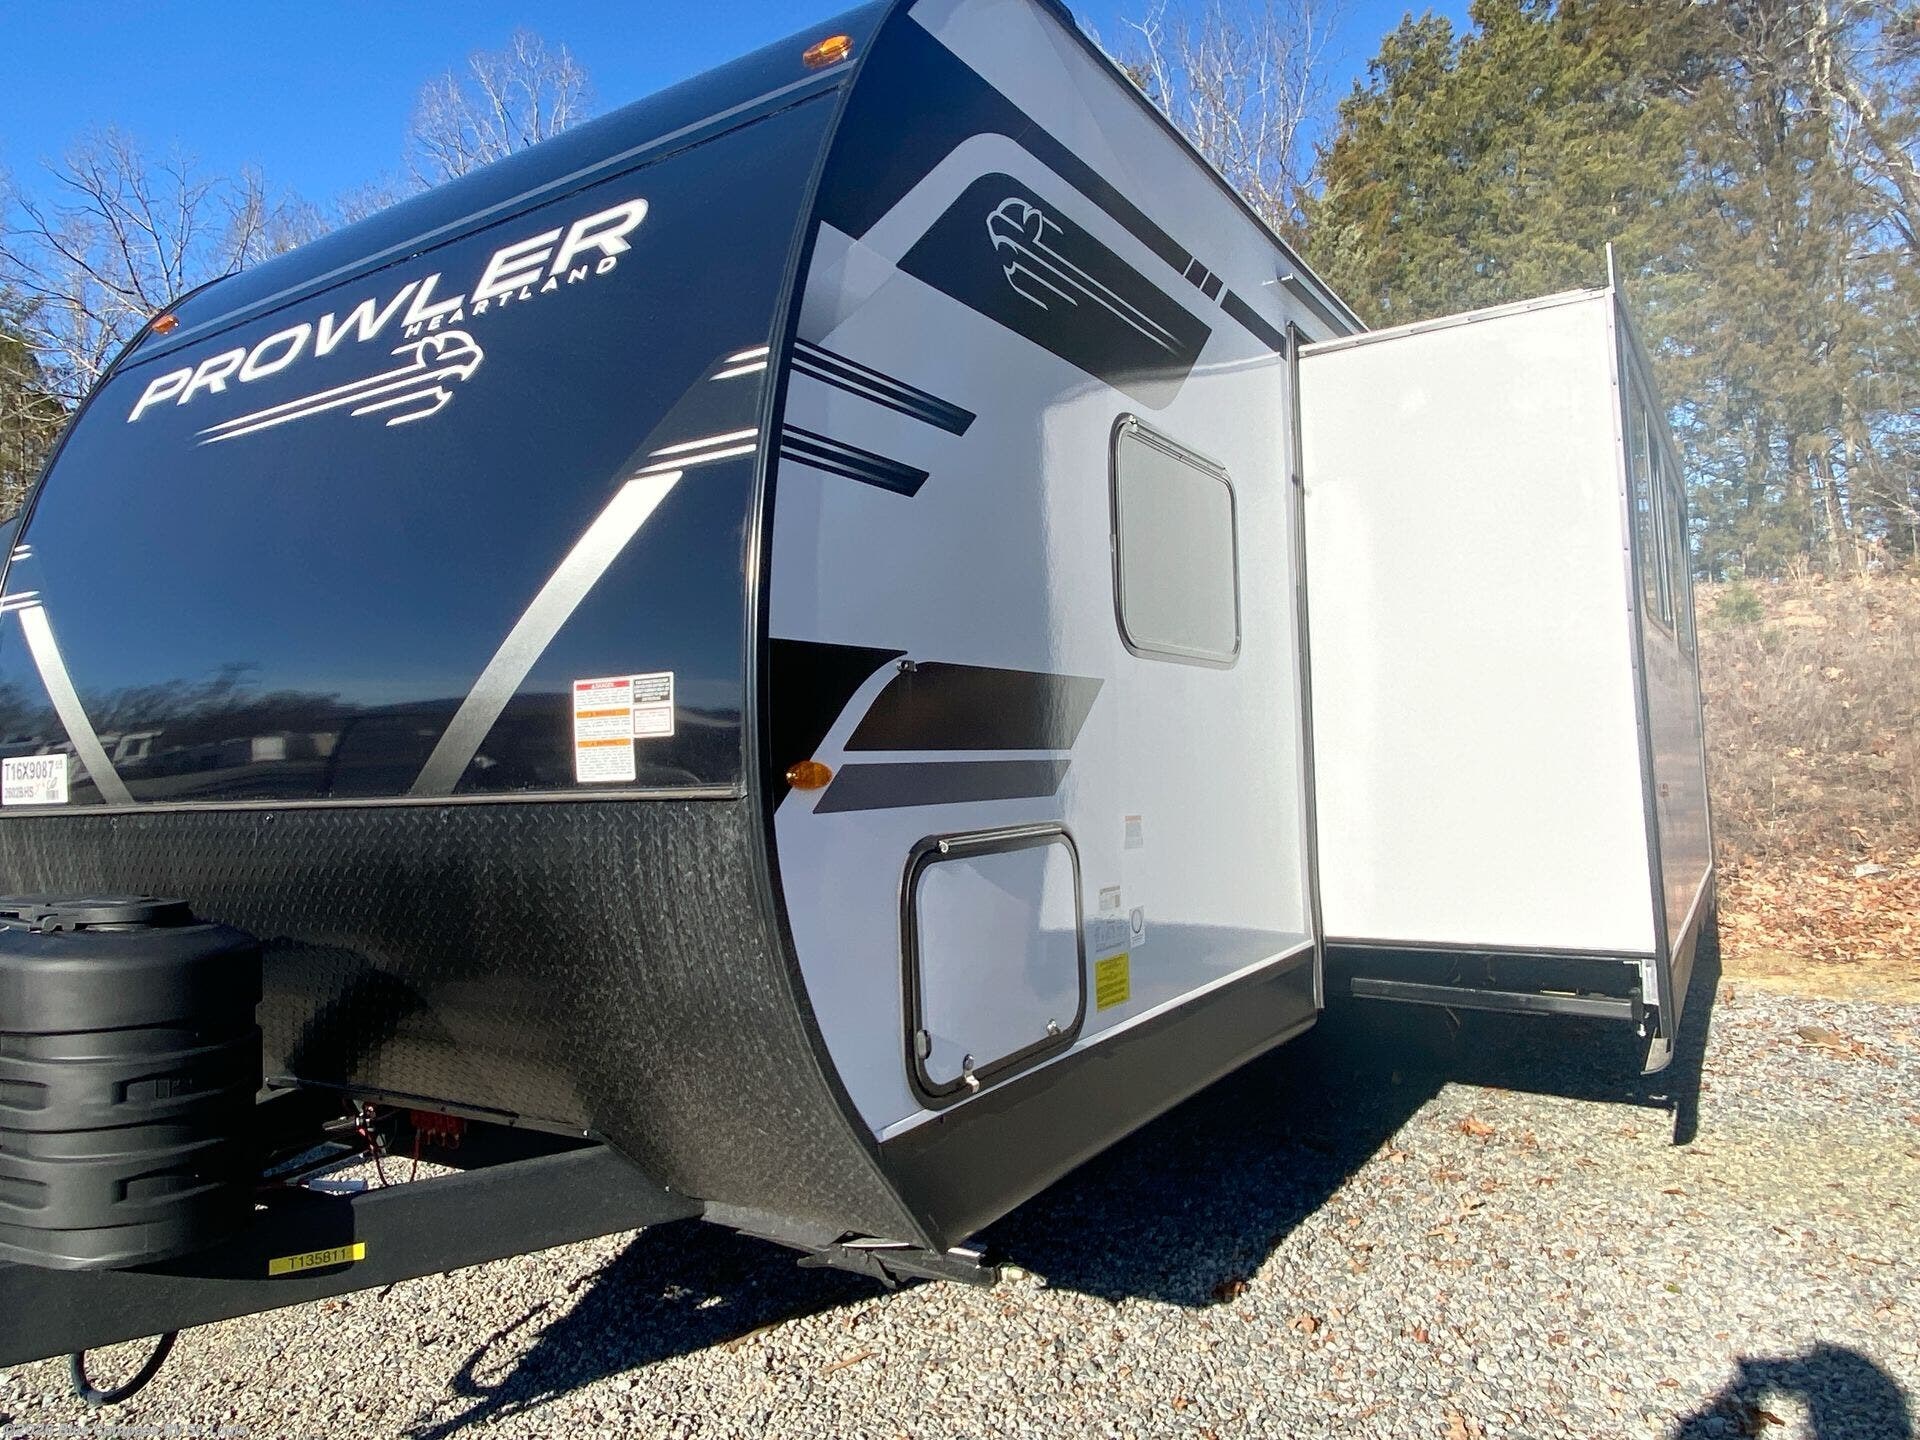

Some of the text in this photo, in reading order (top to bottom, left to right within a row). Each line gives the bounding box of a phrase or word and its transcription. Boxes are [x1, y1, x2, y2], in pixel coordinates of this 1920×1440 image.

[127, 198, 649, 423] PROWLER
[404, 256, 617, 339] HEARTLAND
[5, 760, 54, 780] T16X9087
[288, 1248, 346, 1270] T135811
